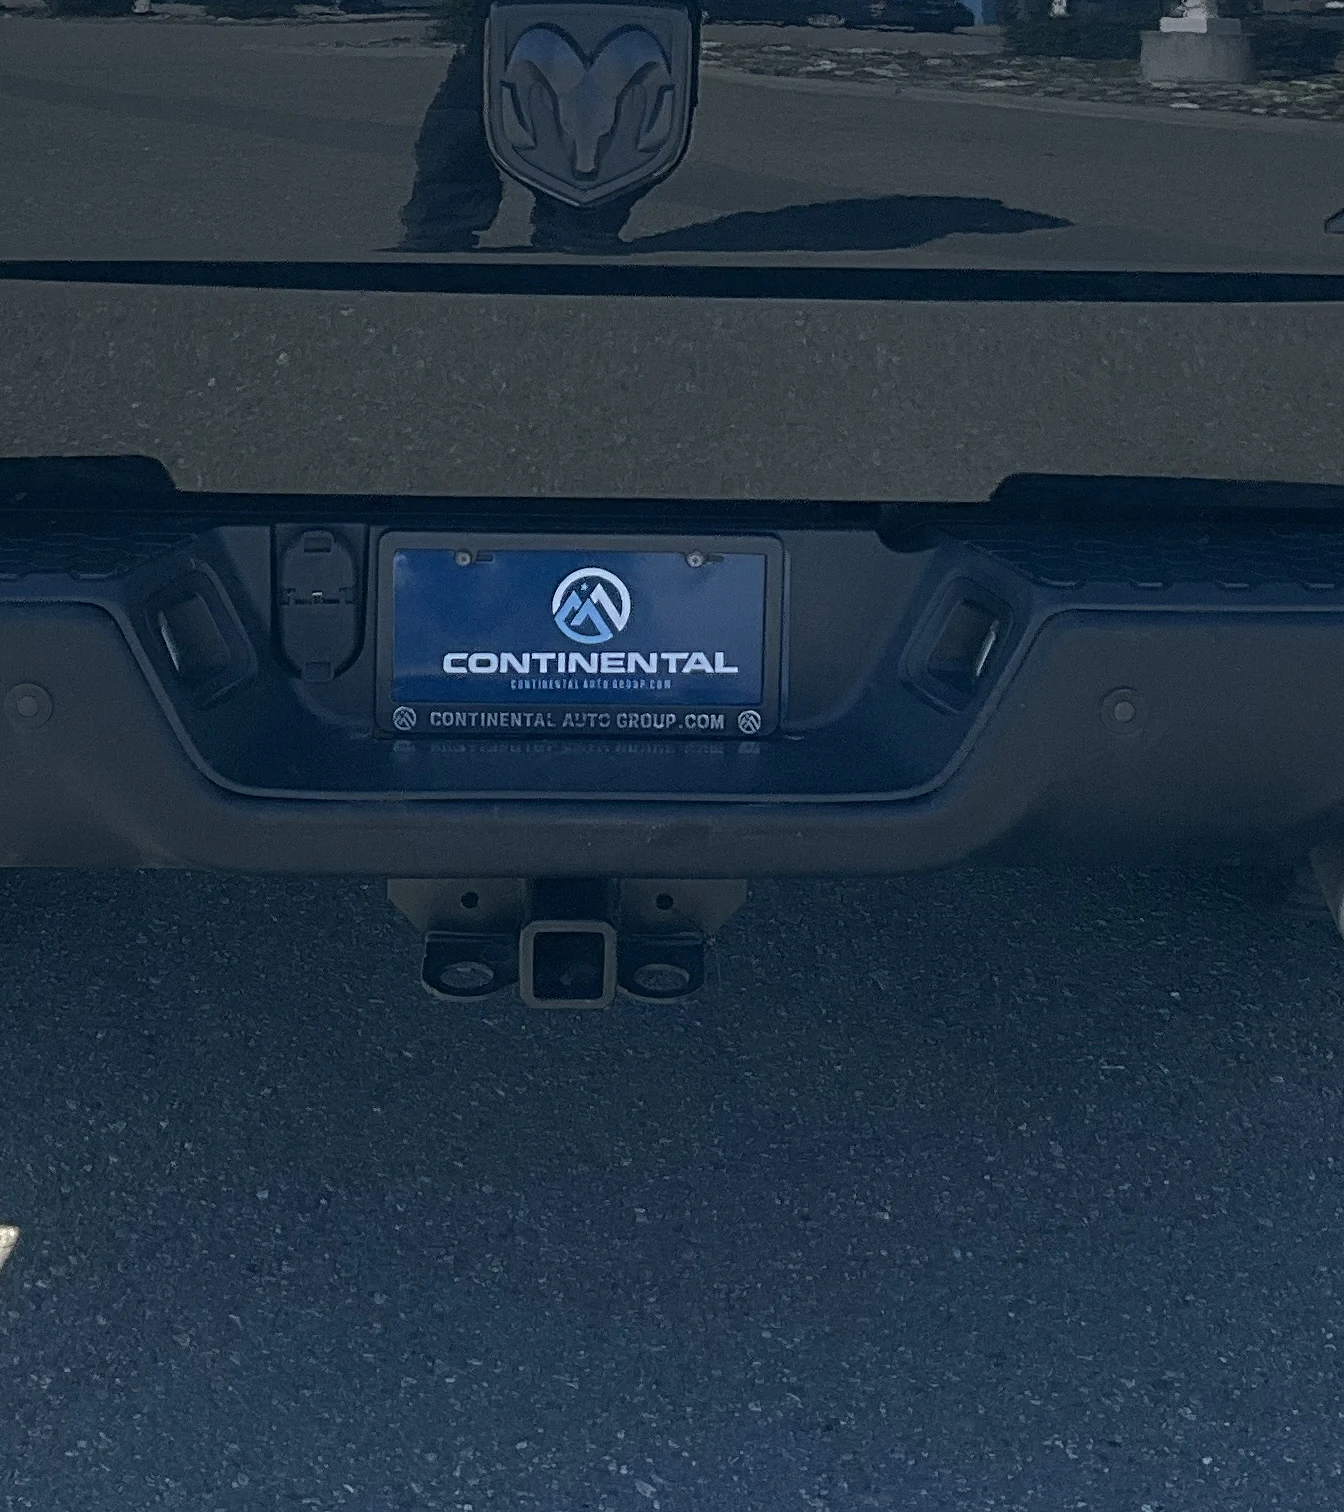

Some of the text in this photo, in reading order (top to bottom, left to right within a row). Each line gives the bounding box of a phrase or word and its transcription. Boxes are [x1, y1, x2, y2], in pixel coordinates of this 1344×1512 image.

[442, 651, 739, 675] CONTINENTAL
[510, 678, 579, 690] CONTINENTAL
[430, 711, 557, 729] CONTINENTAL
[562, 712, 611, 729] AUTO
